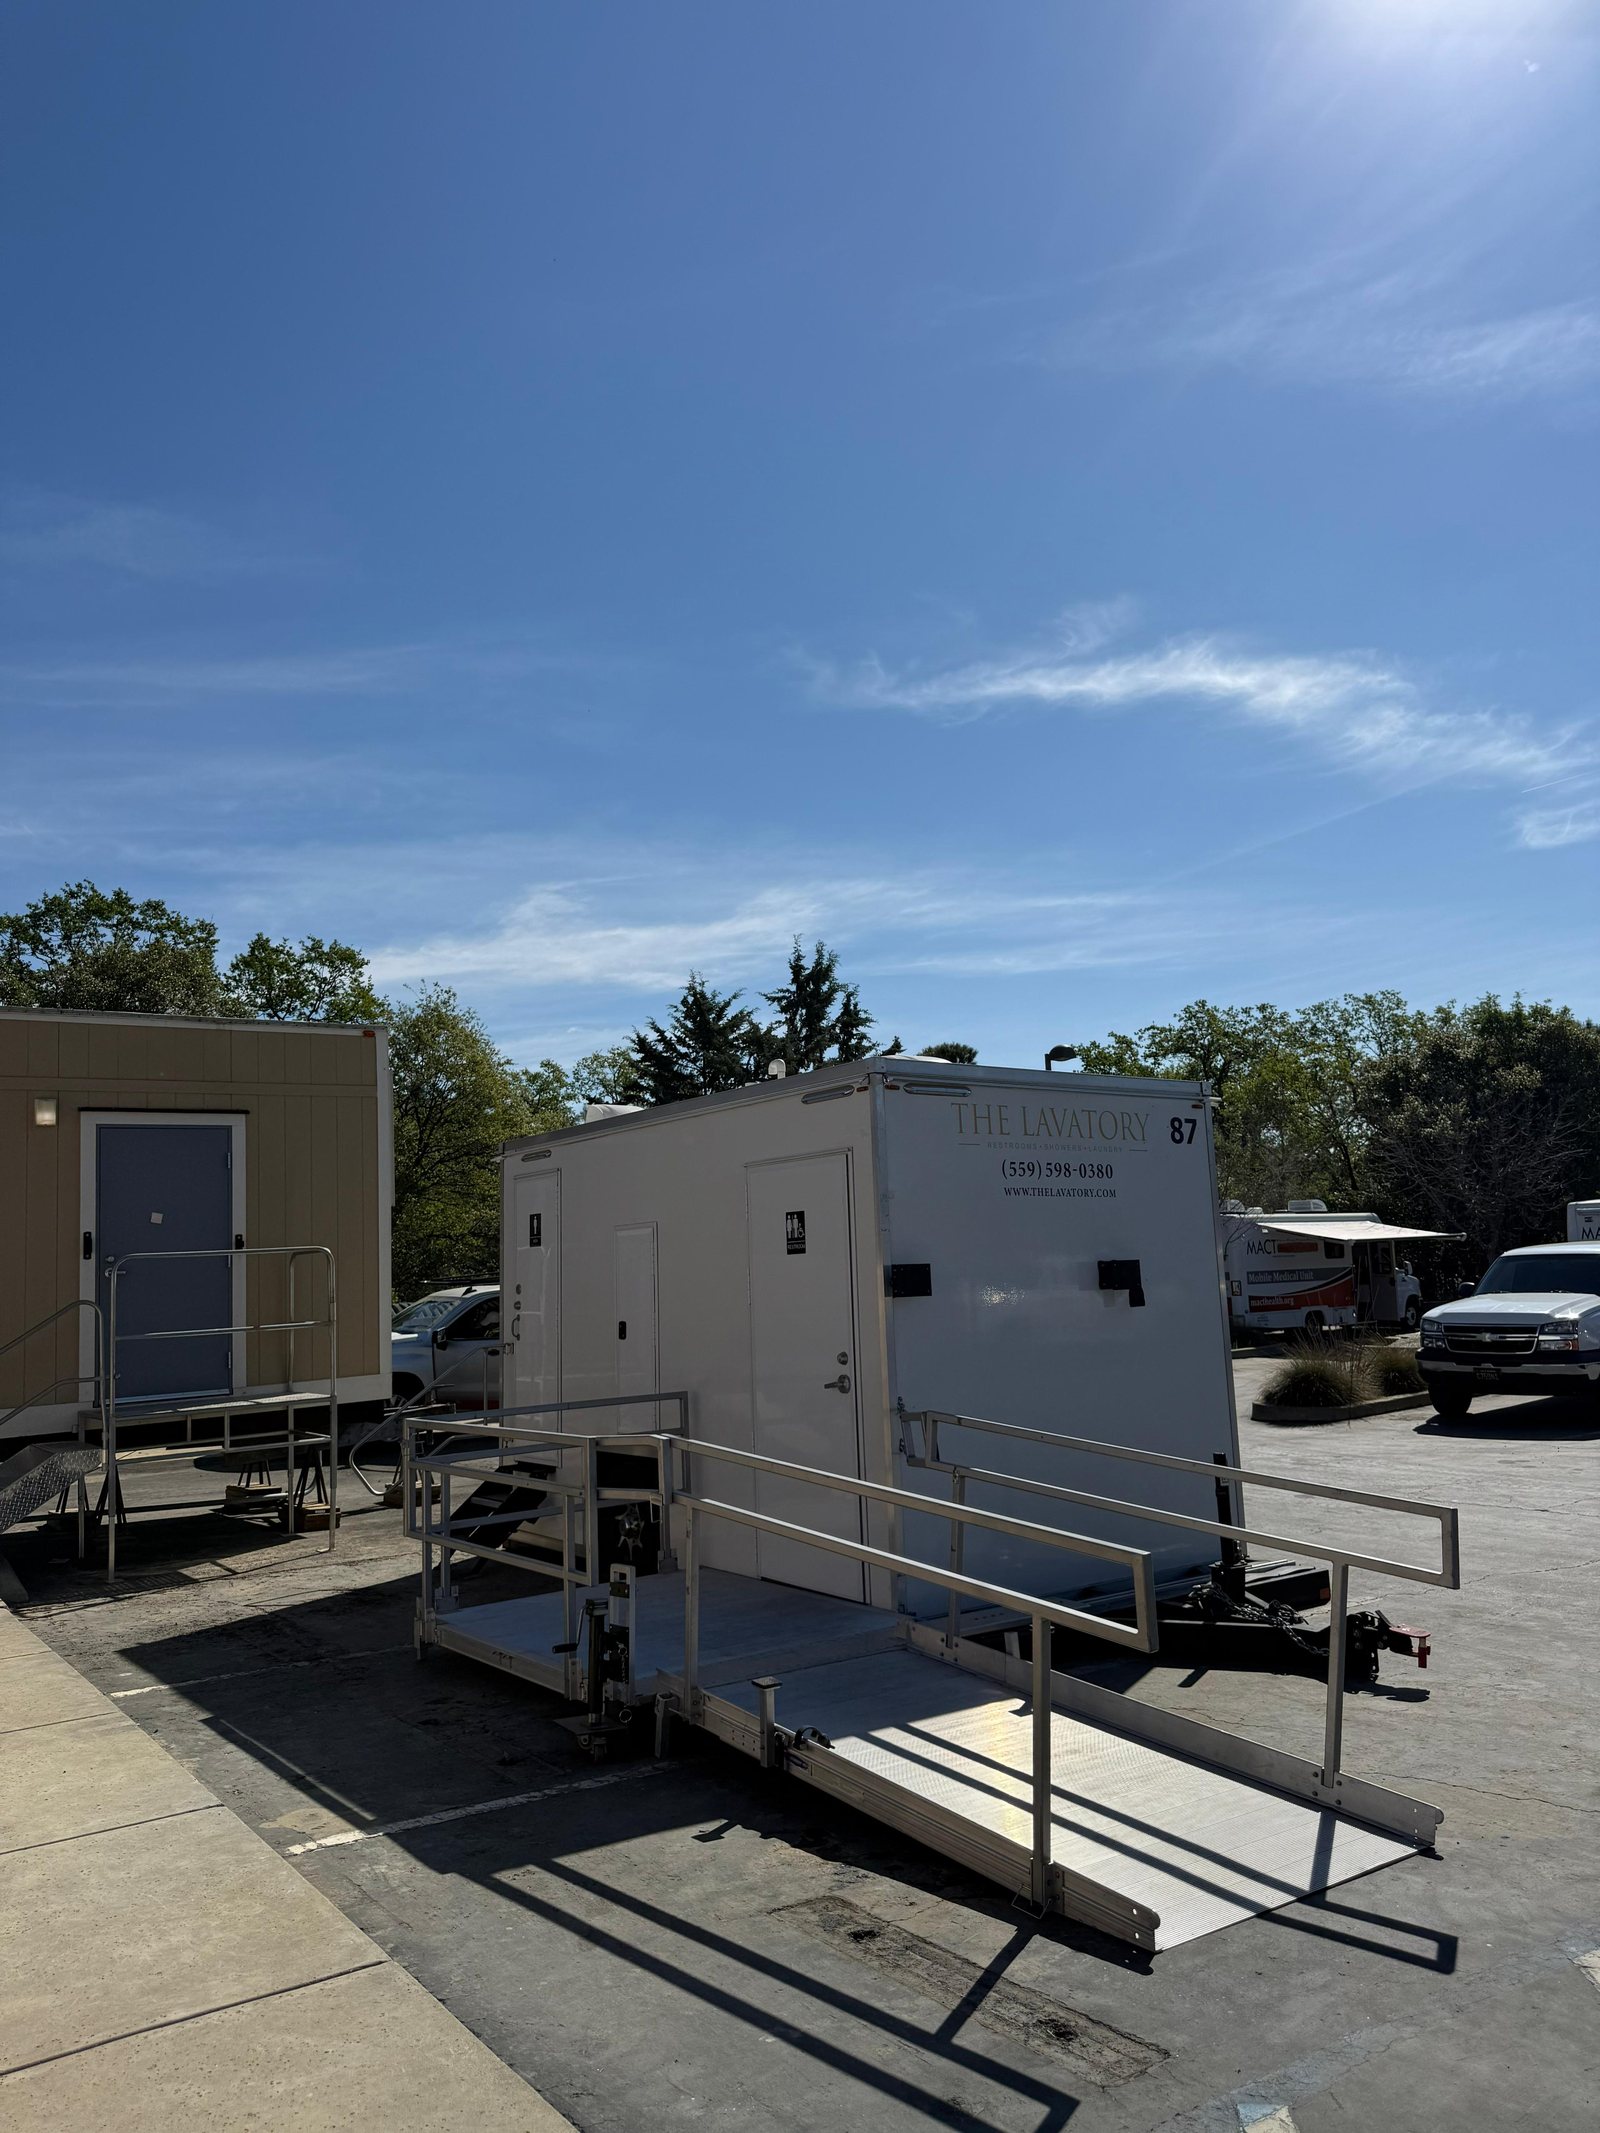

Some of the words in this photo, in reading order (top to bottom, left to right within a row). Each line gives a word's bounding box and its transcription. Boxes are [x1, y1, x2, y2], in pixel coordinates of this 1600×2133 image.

[951, 1102, 1011, 1135] THE
[1022, 1105, 1150, 1142] LAVATORY
[1169, 1116, 1198, 1145] 87
[1001, 1159, 1042, 1181] (559)
[1045, 1161, 1113, 1179] 598-0380
[1003, 1186, 1116, 1198] WWW.THELAVATORY.COM
[1246, 1239, 1277, 1255] MACT
[1248, 1273, 1272, 1283] Mobile
[1272, 1270, 1299, 1282] Medical
[1299, 1270, 1314, 1281] Unit
[1250, 1296, 1294, 1306] macthealth.org
